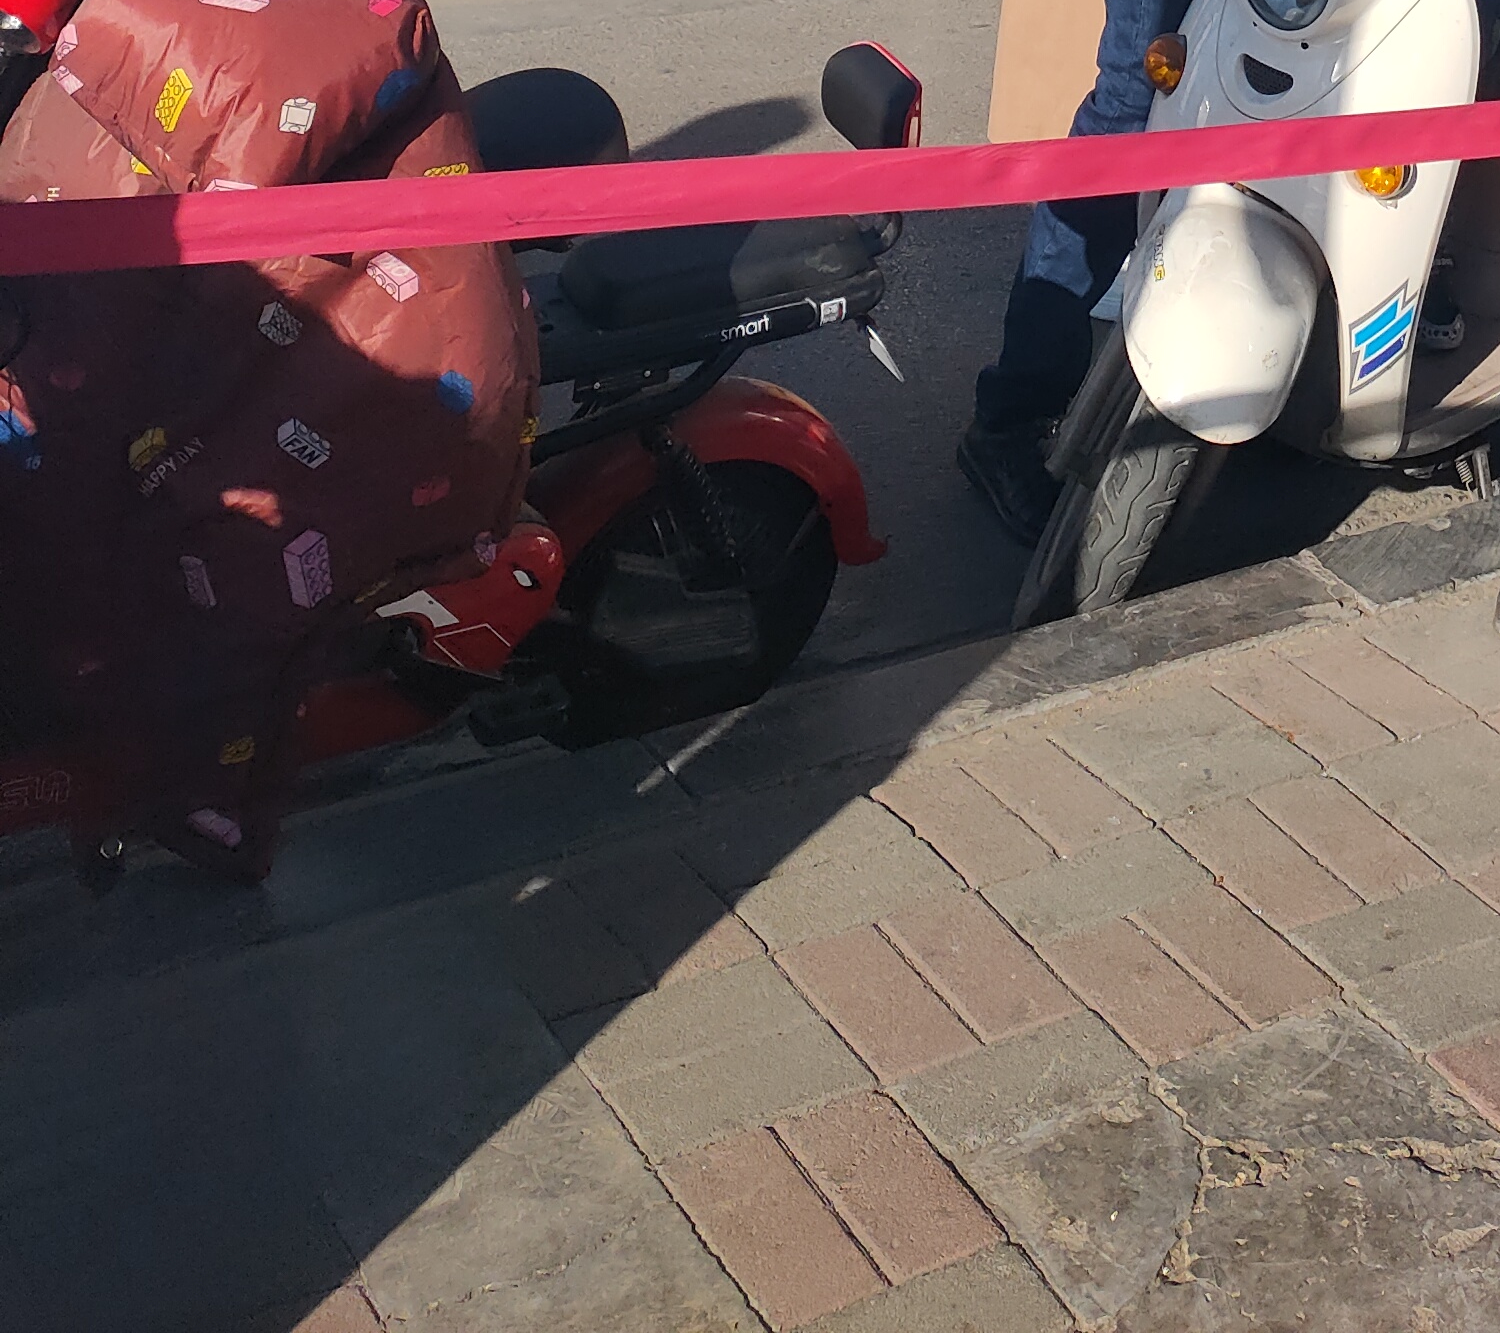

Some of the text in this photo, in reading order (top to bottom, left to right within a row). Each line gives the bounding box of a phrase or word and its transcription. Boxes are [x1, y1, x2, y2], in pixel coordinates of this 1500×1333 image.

[720, 314, 769, 342] smart
[284, 437, 322, 464] FAN
[138, 436, 205, 497] HAPPY DAY
